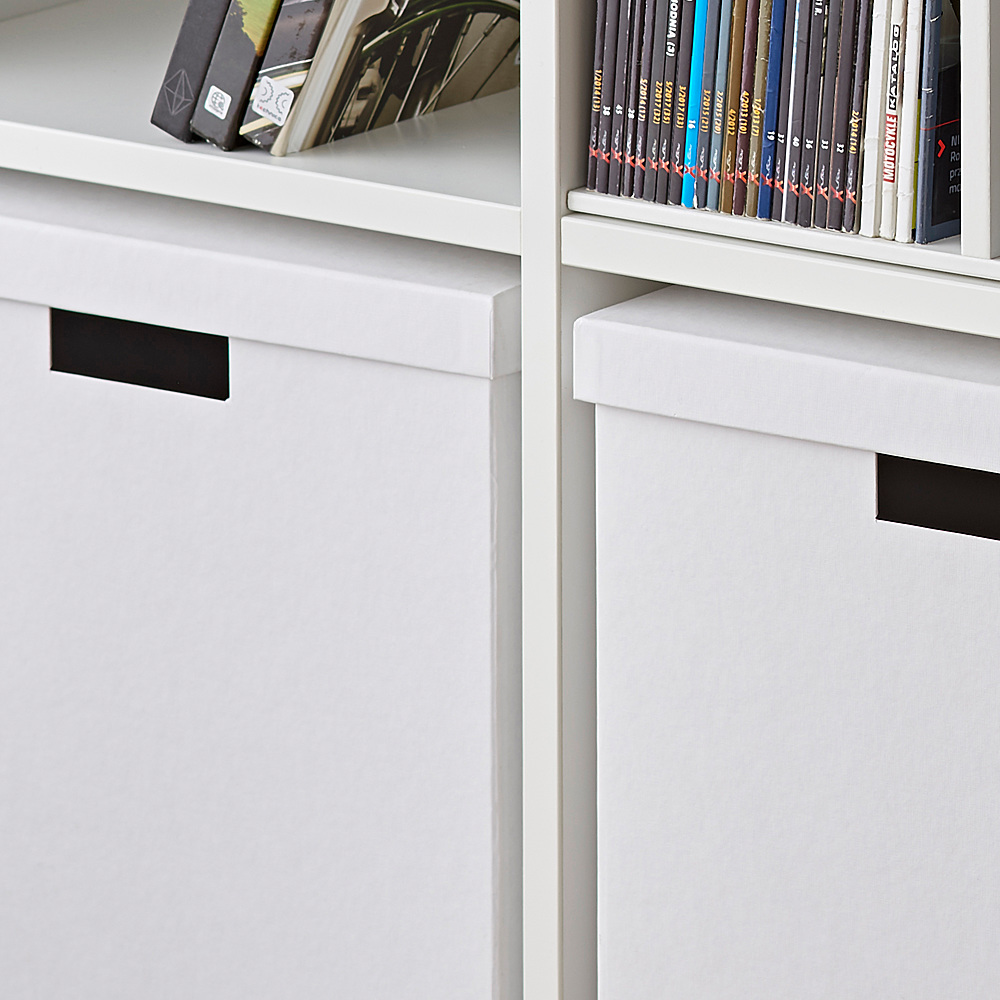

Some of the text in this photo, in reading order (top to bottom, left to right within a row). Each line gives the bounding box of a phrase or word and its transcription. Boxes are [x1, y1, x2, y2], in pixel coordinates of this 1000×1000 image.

[653, 80, 661, 107] 2/2017
[664, 80, 672, 107] 5/2017
[677, 85, 685, 111] 3/2017
[702, 89, 710, 115] 3/2015
[715, 90, 723, 117] 2/2015
[882, 25, 900, 181] MOTOCYKLE KATALOG
[727, 108, 735, 135] 4/2012
